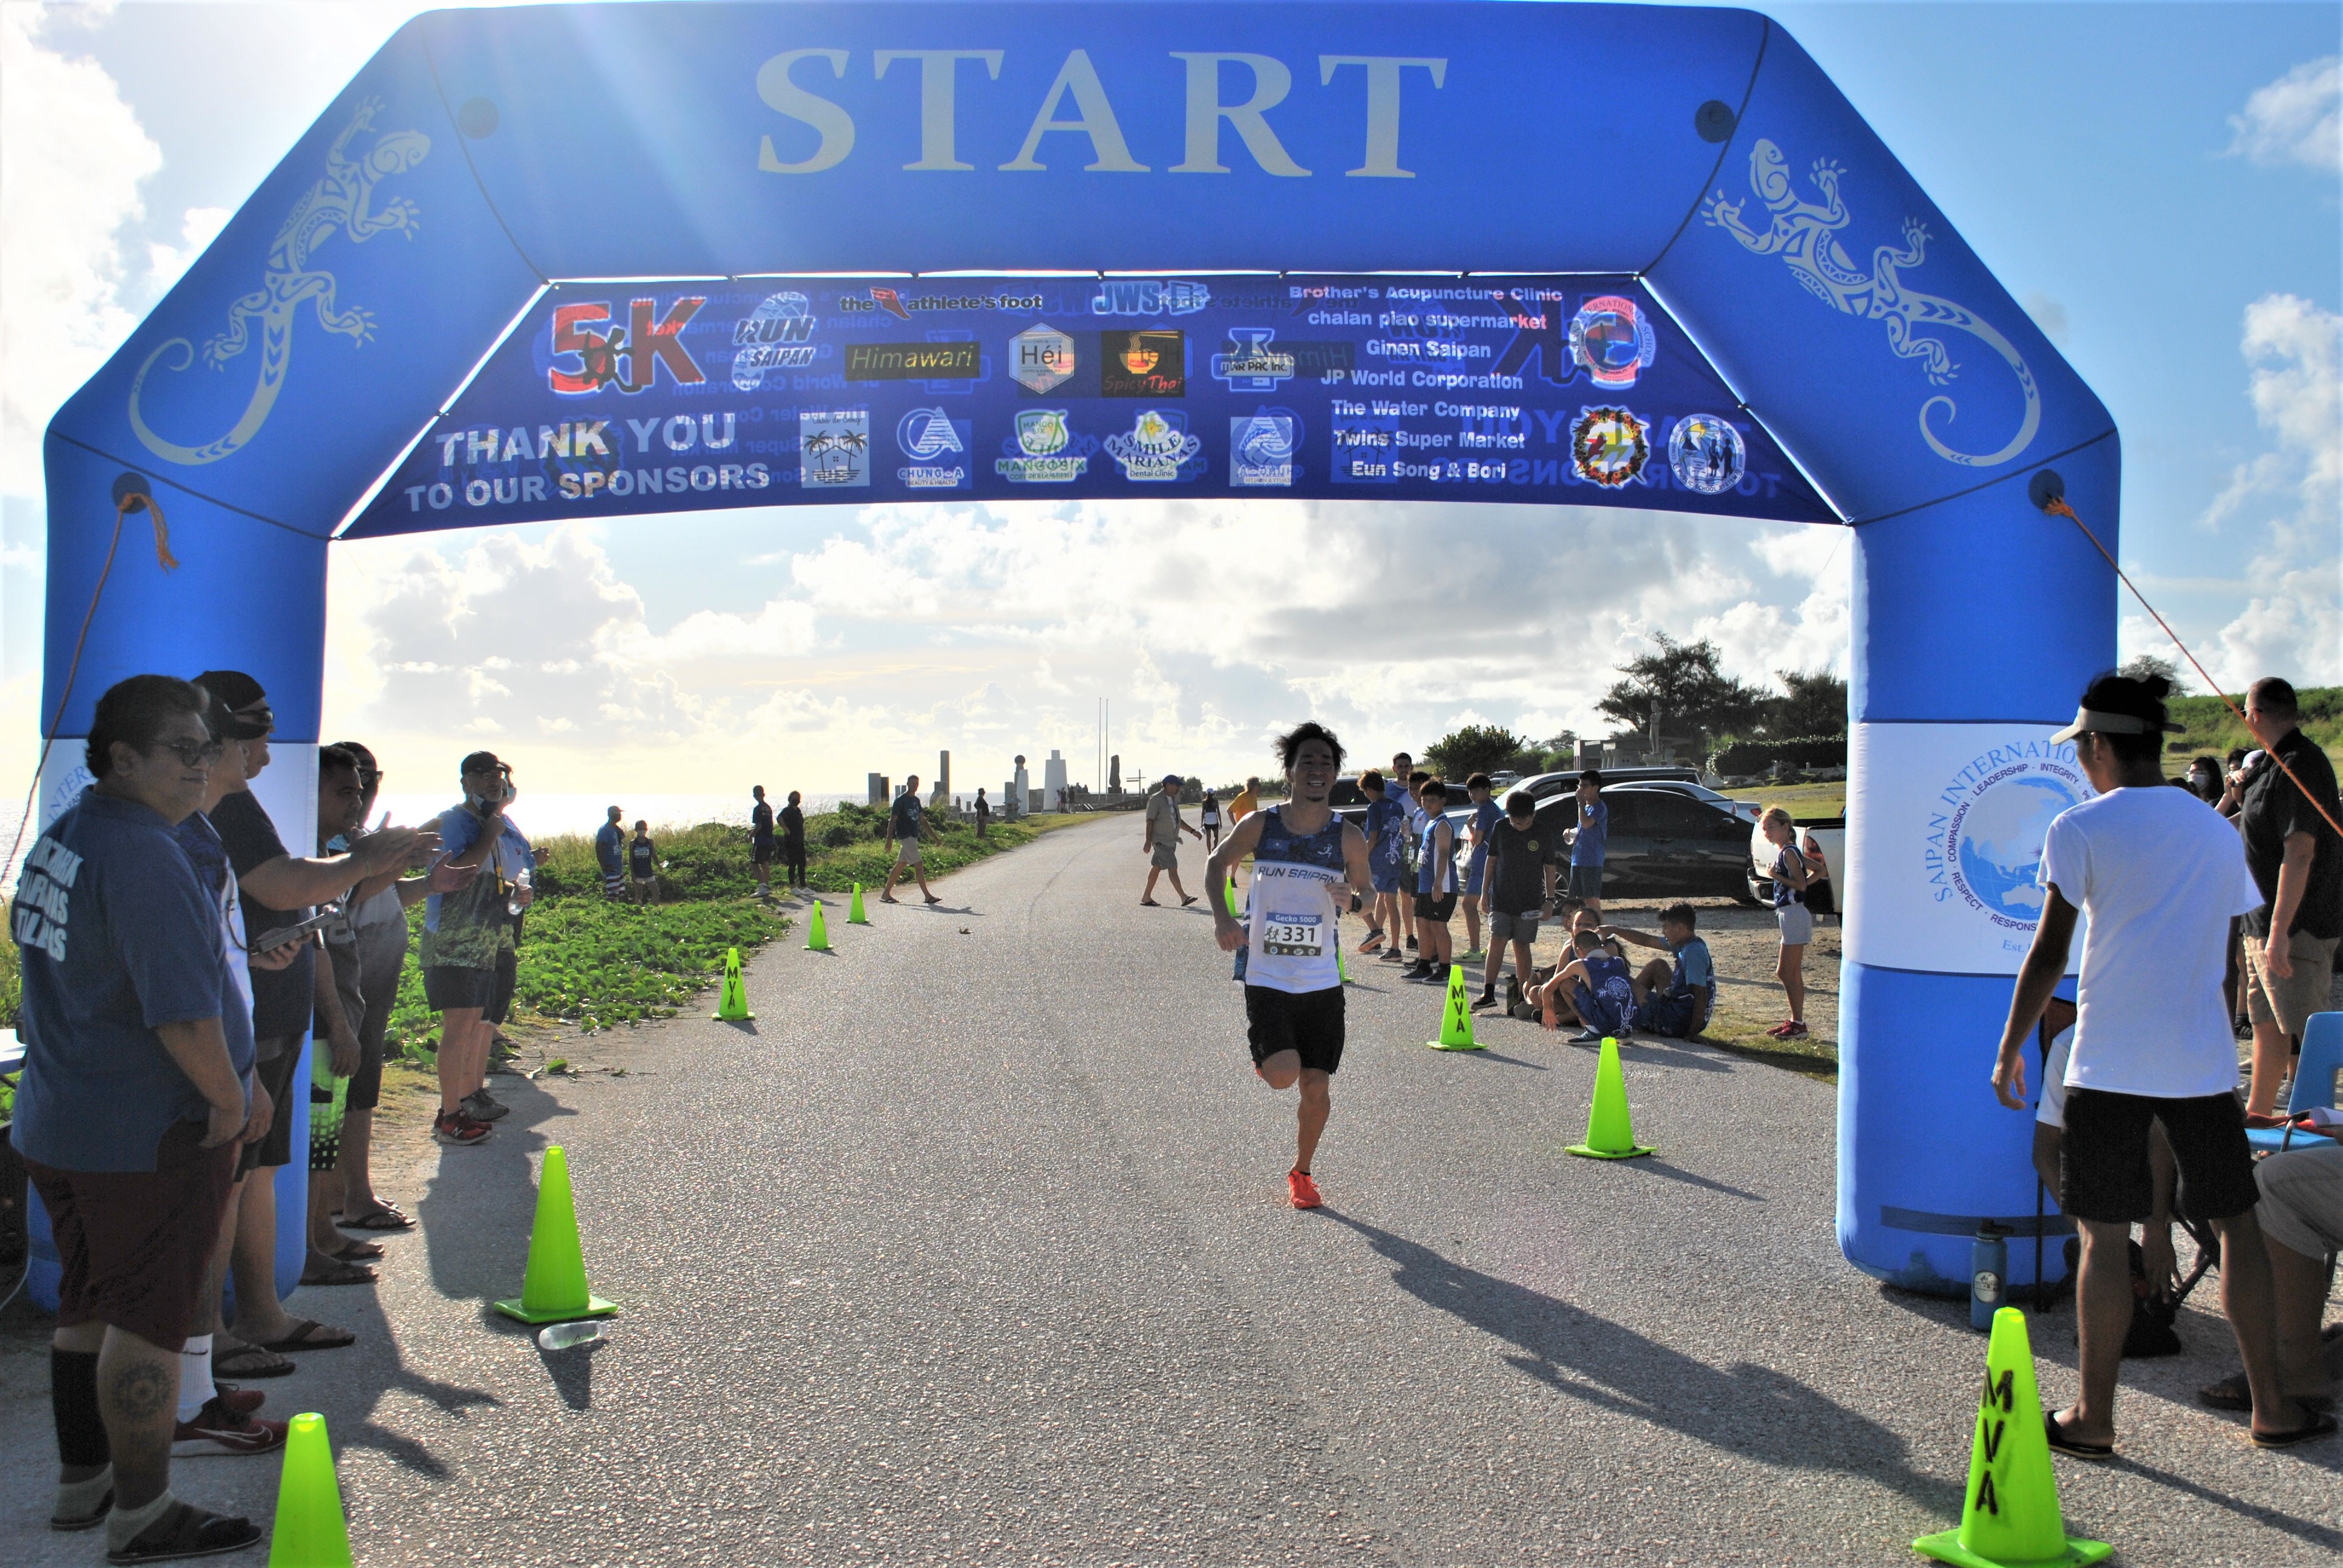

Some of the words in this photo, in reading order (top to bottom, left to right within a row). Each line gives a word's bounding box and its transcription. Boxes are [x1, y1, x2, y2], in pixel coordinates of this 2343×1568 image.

[756, 48, 1449, 178] START
[841, 296, 874, 311] the
[908, 295, 996, 310] athlete's
[1000, 295, 1043, 309] foot
[1289, 287, 1378, 299] Brother's
[1386, 287, 1504, 302] Acupuncture
[1510, 287, 1562, 302] Clinic
[1308, 311, 1372, 325] chalan
[1380, 311, 1419, 328] piao
[1426, 314, 1547, 330] supermarket
[733, 318, 815, 344] RUN
[550, 297, 707, 393] 5K
[1021, 344, 1062, 364] Héi
[1366, 341, 1420, 356] Ginen
[1426, 341, 1491, 359] Saipan
[750, 347, 814, 368] SAIPAN
[851, 345, 974, 370] Himawari
[1248, 362, 1268, 371] PAC
[1271, 362, 1287, 371] Inc.
[1103, 374, 1146, 393] Spicy
[1147, 375, 1183, 390] Thai
[1321, 370, 1345, 386] JP
[1350, 370, 1406, 387] World
[1412, 371, 1523, 390] Corporation
[1332, 399, 1365, 415] The
[1370, 400, 1428, 416] Water
[1435, 402, 1520, 422] Company
[435, 420, 610, 466] THANK
[627, 413, 736, 452] YOU
[1124, 434, 1182, 455] SMILE
[1334, 430, 1389, 446] Twins
[1394, 431, 1453, 450] Super
[1460, 432, 1525, 449] Market
[1107, 438, 1198, 468] MARIANAS
[998, 460, 1086, 472] MANGOSIX
[1352, 461, 1386, 477] Eun
[1394, 461, 1440, 480] Song
[1446, 462, 1461, 477] &
[1467, 463, 1506, 479] Bori
[404, 483, 453, 512] TO
[465, 477, 547, 506] OUR
[558, 463, 770, 500] SPONSORS
[1677, 469, 1694, 488] PUBLIC
[1925, 812, 1954, 903] SAIPAN
[1941, 739, 2099, 808] INTERNATIO
[1947, 802, 1970, 863] COMPASSION
[1972, 763, 2028, 797] LEADERSHIP
[2040, 762, 2079, 785] INTEGRITY
[1258, 866, 1286, 878] RUN
[1289, 869, 1338, 883] SAIPAN
[1951, 872, 1984, 912] RESPECT
[1275, 914, 1297, 923] Gecko
[1282, 926, 1316, 943] 331
[2002, 939, 2025, 952] Est.
[727, 966, 738, 1010] MVA
[1451, 985, 1466, 1034] MVA
[1975, 1365, 2014, 1515] MVA
